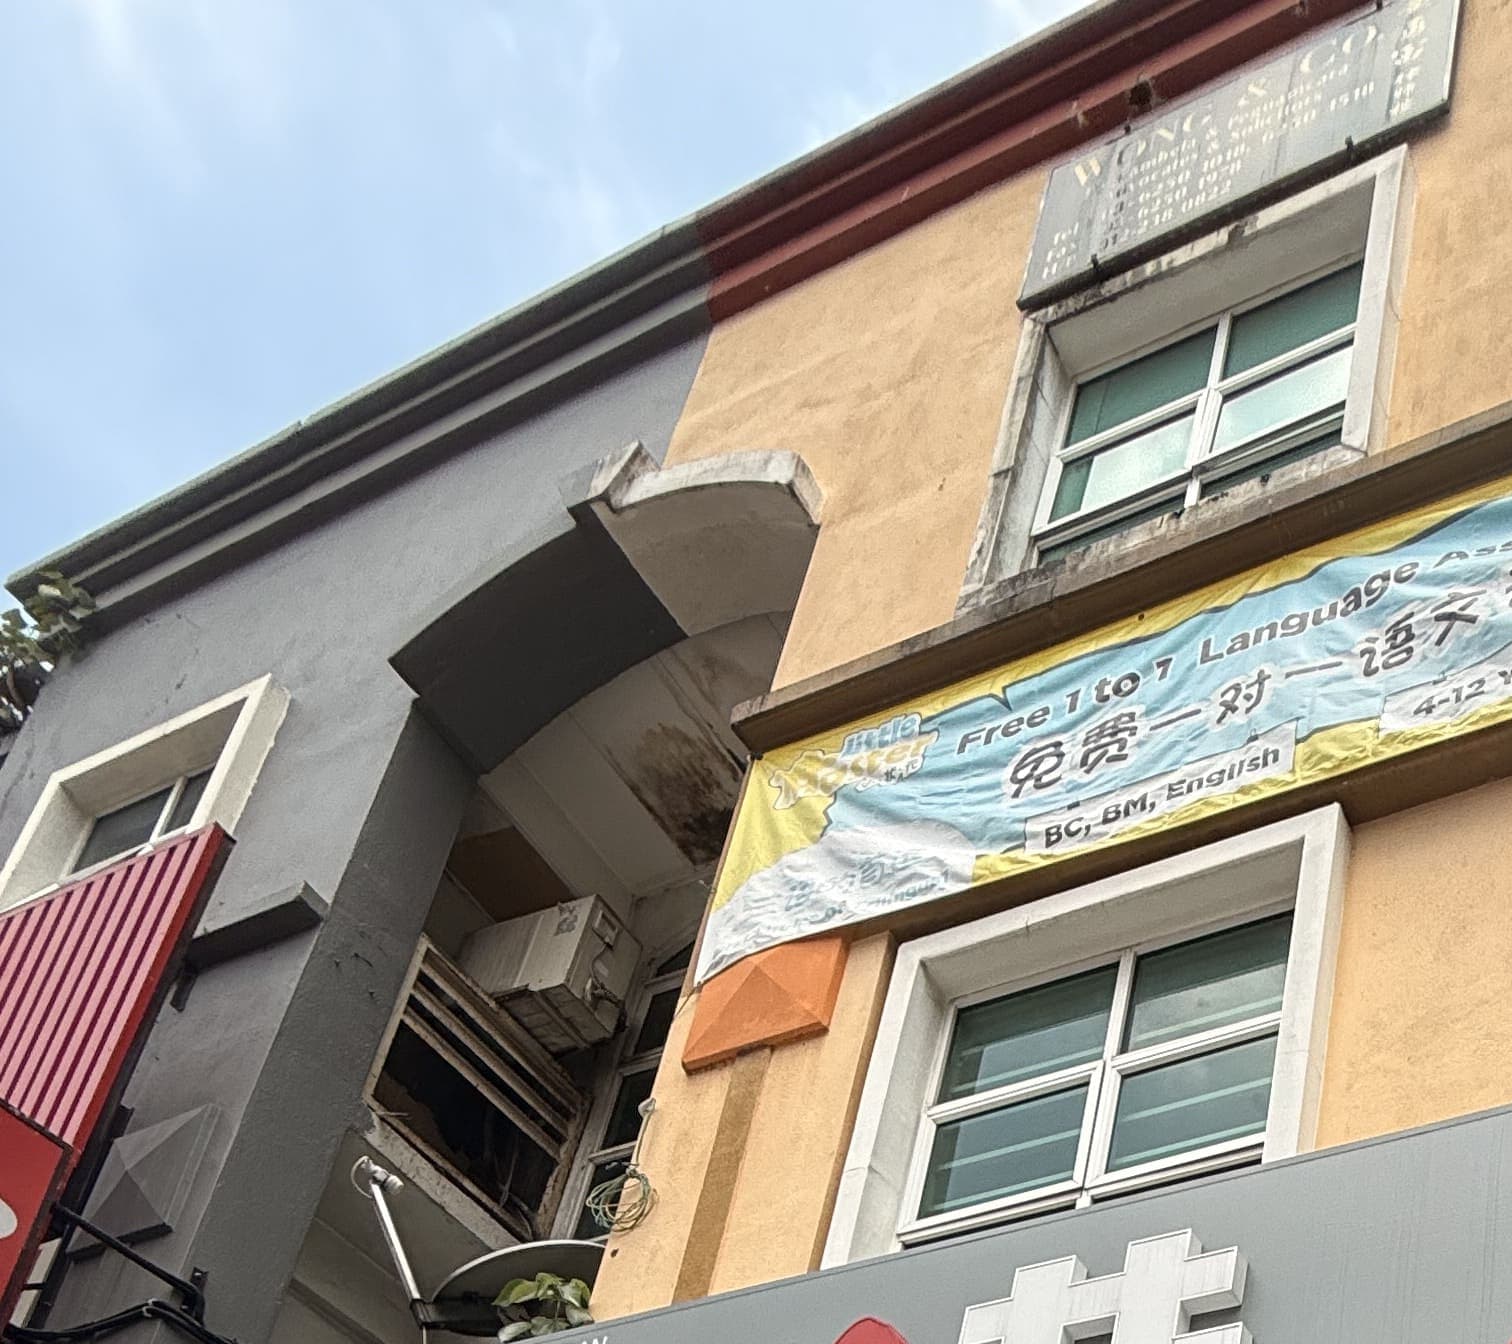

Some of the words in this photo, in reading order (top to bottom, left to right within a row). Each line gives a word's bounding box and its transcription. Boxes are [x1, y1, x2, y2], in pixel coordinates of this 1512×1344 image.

[956, 703, 1052, 755] Free
[1093, 670, 1142, 702] to
[1199, 559, 1420, 664] Language
[1411, 677, 1486, 718] 4-12
[1044, 815, 1092, 849] BC,
[1101, 788, 1157, 827] BM,
[1166, 743, 1280, 802] English
